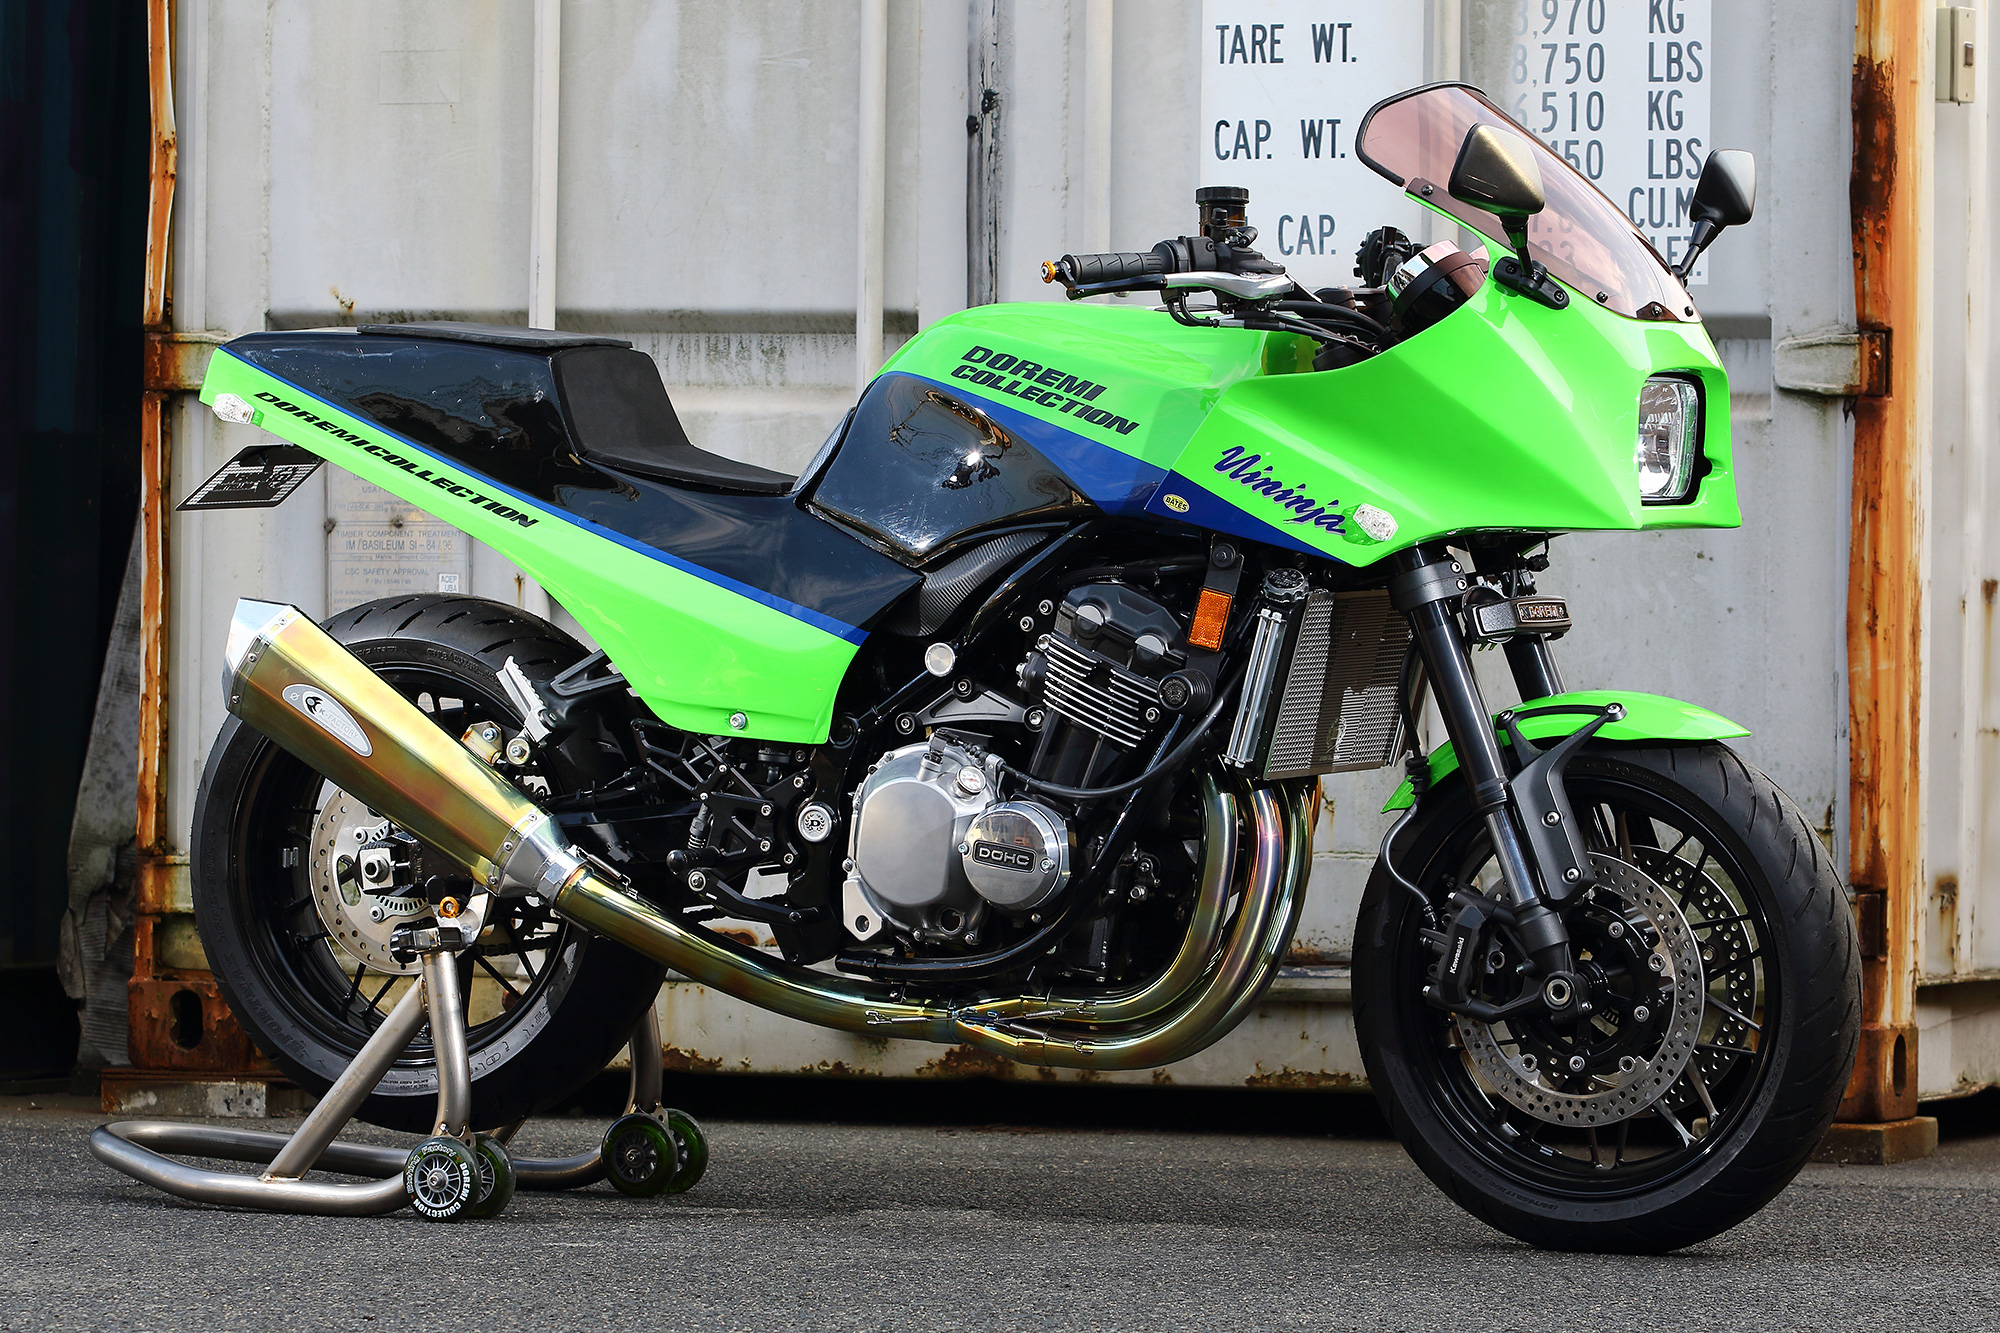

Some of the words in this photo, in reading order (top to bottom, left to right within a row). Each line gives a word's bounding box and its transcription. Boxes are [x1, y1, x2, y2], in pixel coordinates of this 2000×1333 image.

[1648, 0, 1684, 34] KG
[1215, 24, 1284, 64] TARE
[1311, 23, 1357, 63] WT.
[1511, 42, 1605, 87] 8,750
[1648, 41, 1703, 83] LBS
[1648, 89, 1684, 131] KG
[1214, 119, 1272, 161] CAP.
[1300, 119, 1346, 159] WT.
[1647, 138, 1702, 180] LBS
[1278, 214, 1337, 256] CAP.
[961, 345, 1108, 402] DOREMI
[950, 364, 1141, 435] COLLECTION
[1165, 496, 1187, 511] BATES
[336, 530, 364, 538] TIMBER
[366, 530, 414, 538] COMPONENT
[418, 530, 461, 538] TREATMENT
[344, 567, 360, 575] CSC
[363, 567, 390, 575] SAFETY
[393, 567, 430, 576] APPROVAL
[441, 575, 457, 583] ACEP
[445, 584, 457, 592] USA
[979, 847, 1030, 866] DOHC
[1449, 936, 1465, 974] Kawasaki
[459, 1162, 471, 1202] DOREMI
[413, 1198, 462, 1218] COLLECTION
